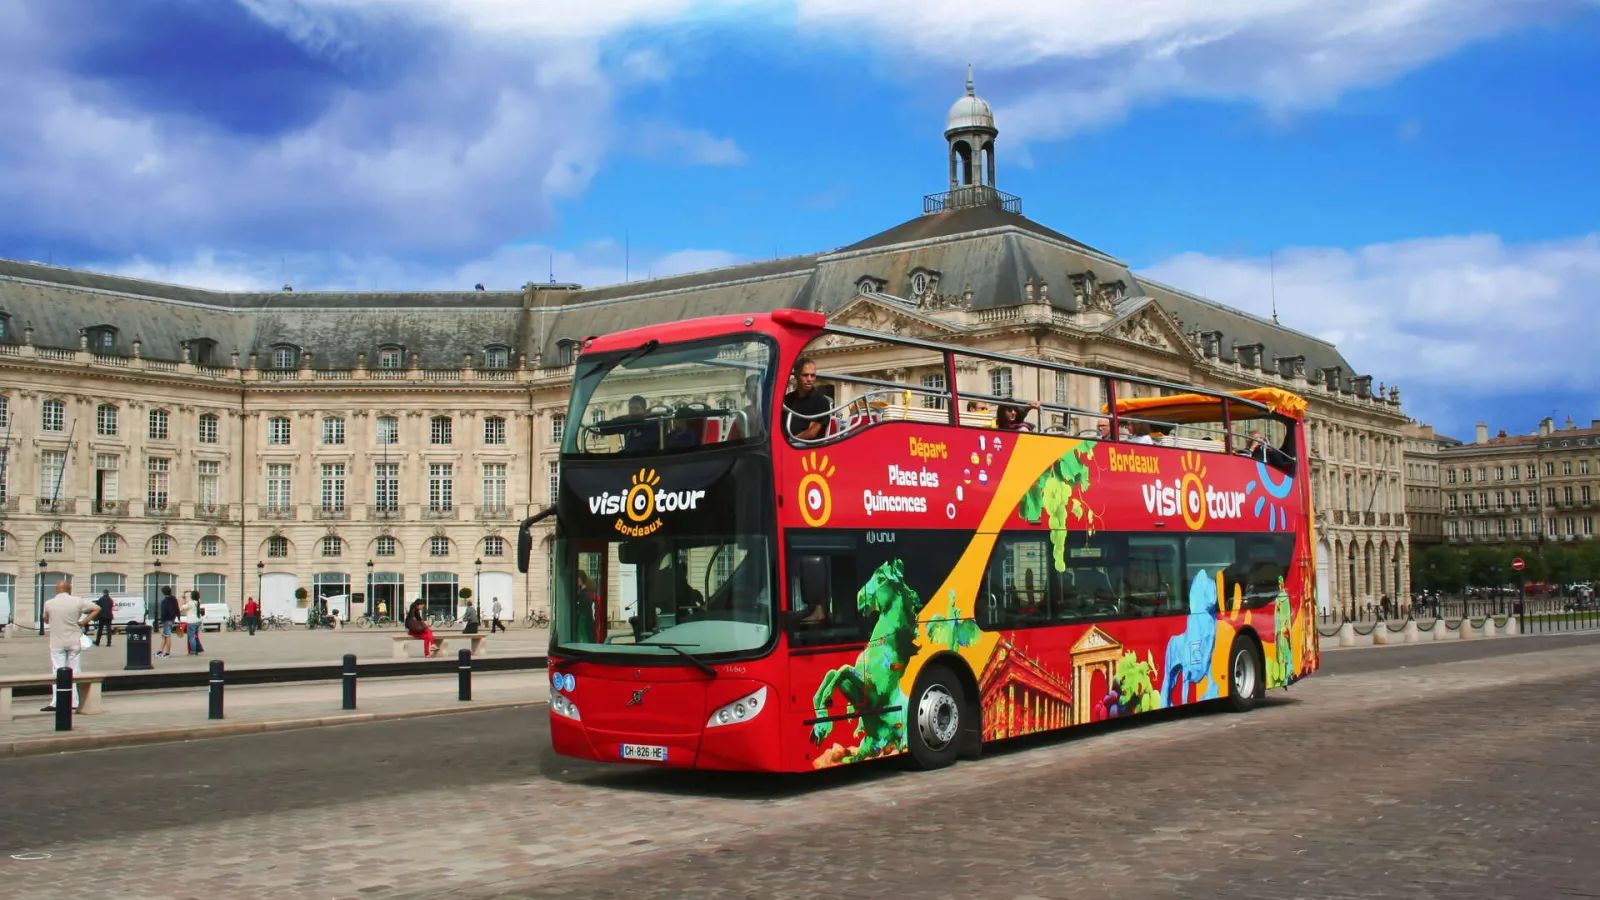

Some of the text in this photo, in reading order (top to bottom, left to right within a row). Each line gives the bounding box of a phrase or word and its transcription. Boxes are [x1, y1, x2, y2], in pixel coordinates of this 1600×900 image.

[909, 436, 948, 463] Départ
[1108, 447, 1160, 474] Bordeaux
[888, 464, 939, 487] Place des
[863, 489, 927, 516] Quinconces
[614, 518, 664, 537] Bordeaux
